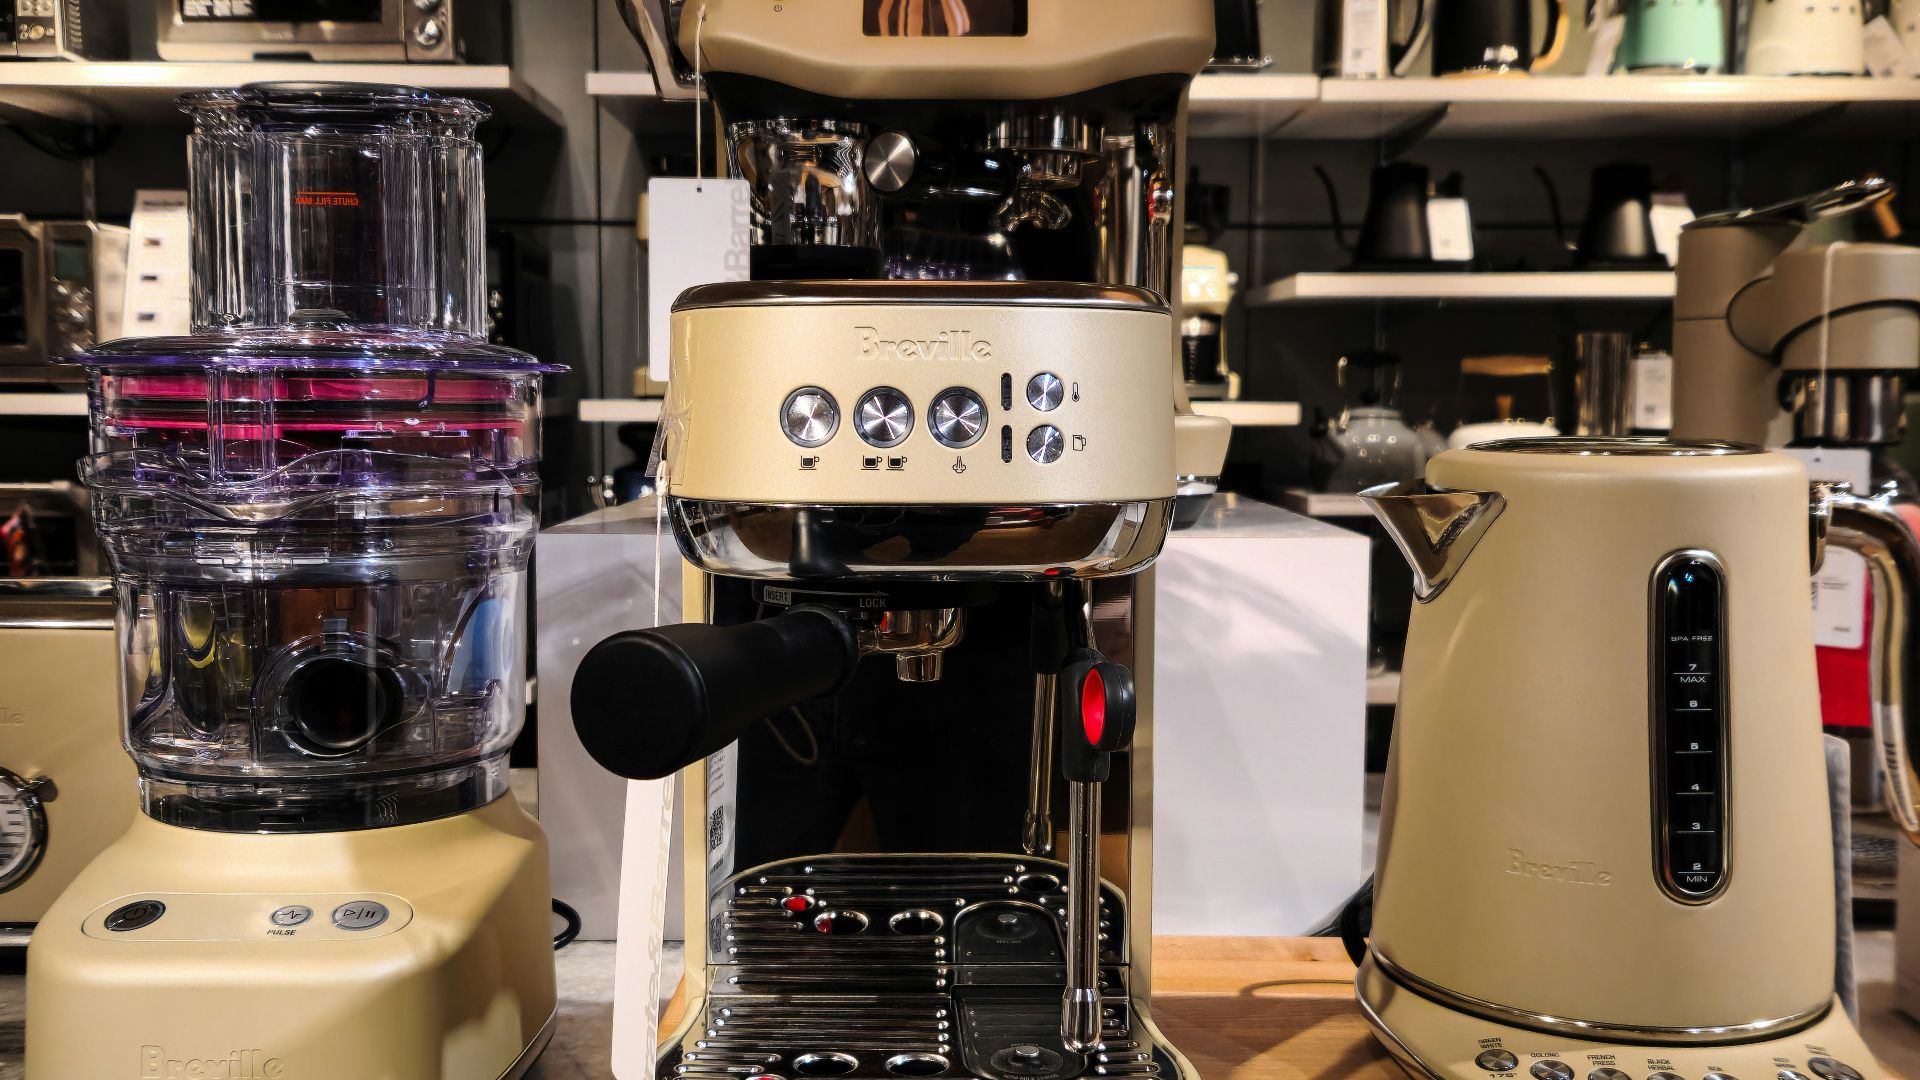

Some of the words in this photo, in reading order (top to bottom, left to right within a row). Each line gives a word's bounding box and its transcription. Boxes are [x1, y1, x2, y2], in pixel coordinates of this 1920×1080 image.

[854, 326, 993, 362] Breville
[765, 588, 789, 603] INSERT
[860, 597, 887, 608] LOCK
[1688, 663, 1697, 671] 7
[1680, 675, 1706, 683] MAX
[1690, 742, 1699, 750] 5
[1691, 783, 1700, 791] 4
[1692, 822, 1701, 830] 3
[1504, 846, 1612, 887] Breville
[1692, 862, 1702, 871] 2
[1686, 875, 1708, 883] MIN
[140, 1044, 285, 1080] Breville
